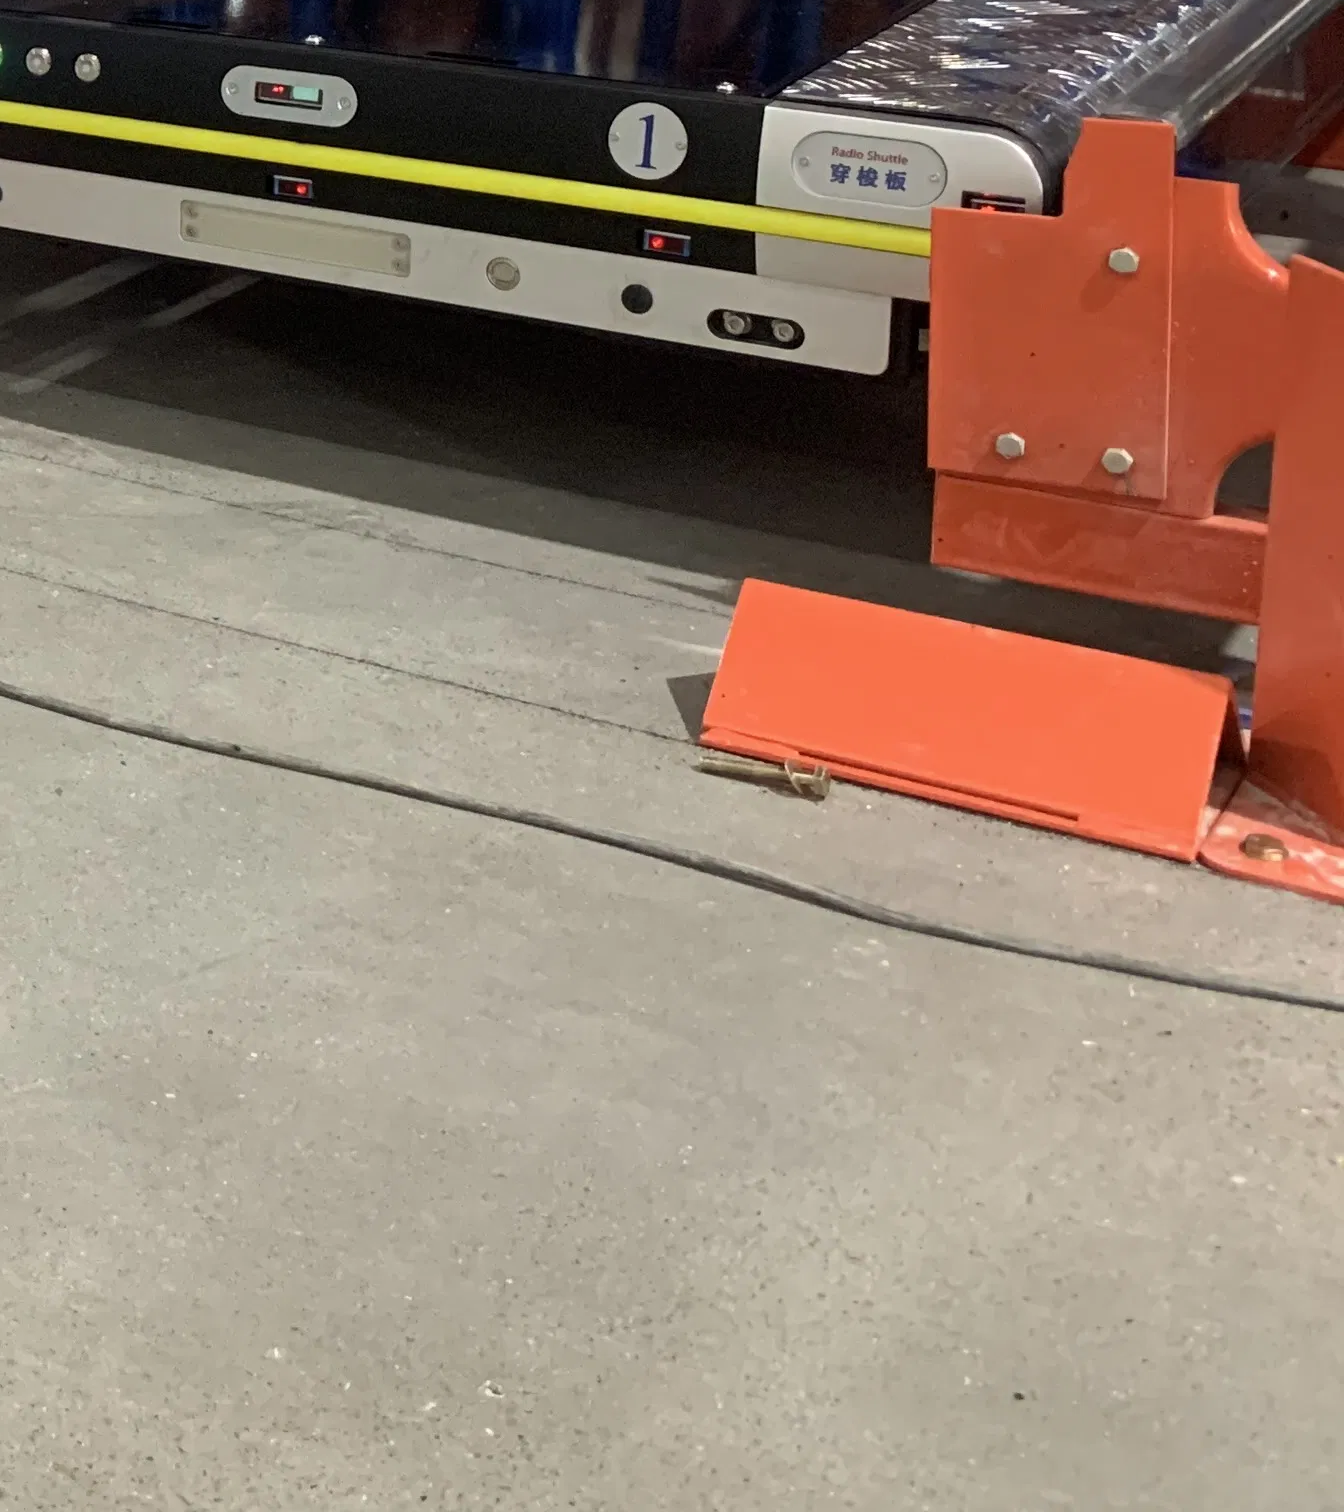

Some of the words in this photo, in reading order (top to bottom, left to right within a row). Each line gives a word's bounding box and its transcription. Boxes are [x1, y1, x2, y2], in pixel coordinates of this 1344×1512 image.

[635, 114, 657, 170] 1
[831, 146, 864, 160] Radio
[867, 150, 909, 166] Shuttle
[830, 163, 907, 192] 穿梭板
